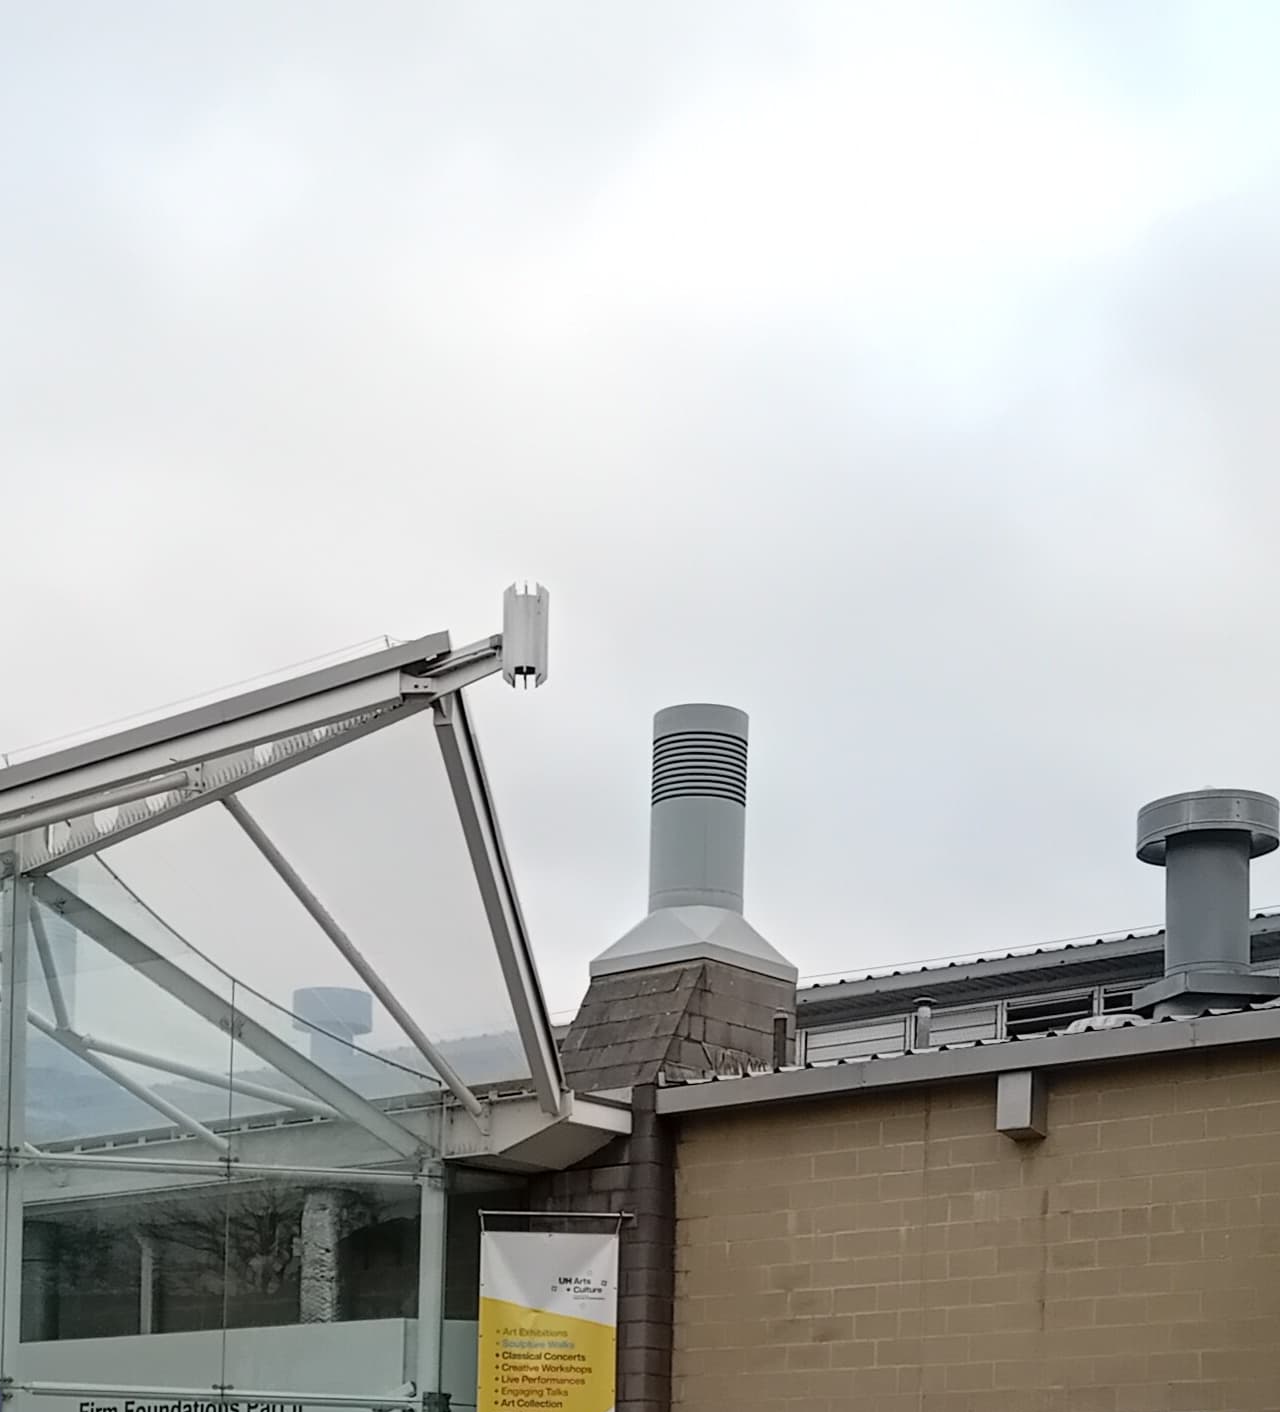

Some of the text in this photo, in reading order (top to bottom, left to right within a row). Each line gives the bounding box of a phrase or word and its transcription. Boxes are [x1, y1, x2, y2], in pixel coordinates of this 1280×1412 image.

[558, 1277, 591, 1285] UH Arts
[573, 1286, 602, 1294] Culture
[503, 1328, 568, 1337] Art Exhibitions
[502, 1351, 586, 1361] Classical Concerts
[502, 1363, 593, 1374] Creative Workshops
[501, 1376, 585, 1385] Live Performances
[501, 1387, 568, 1397] Engaging Talks
[501, 1399, 563, 1408] Art Collection
